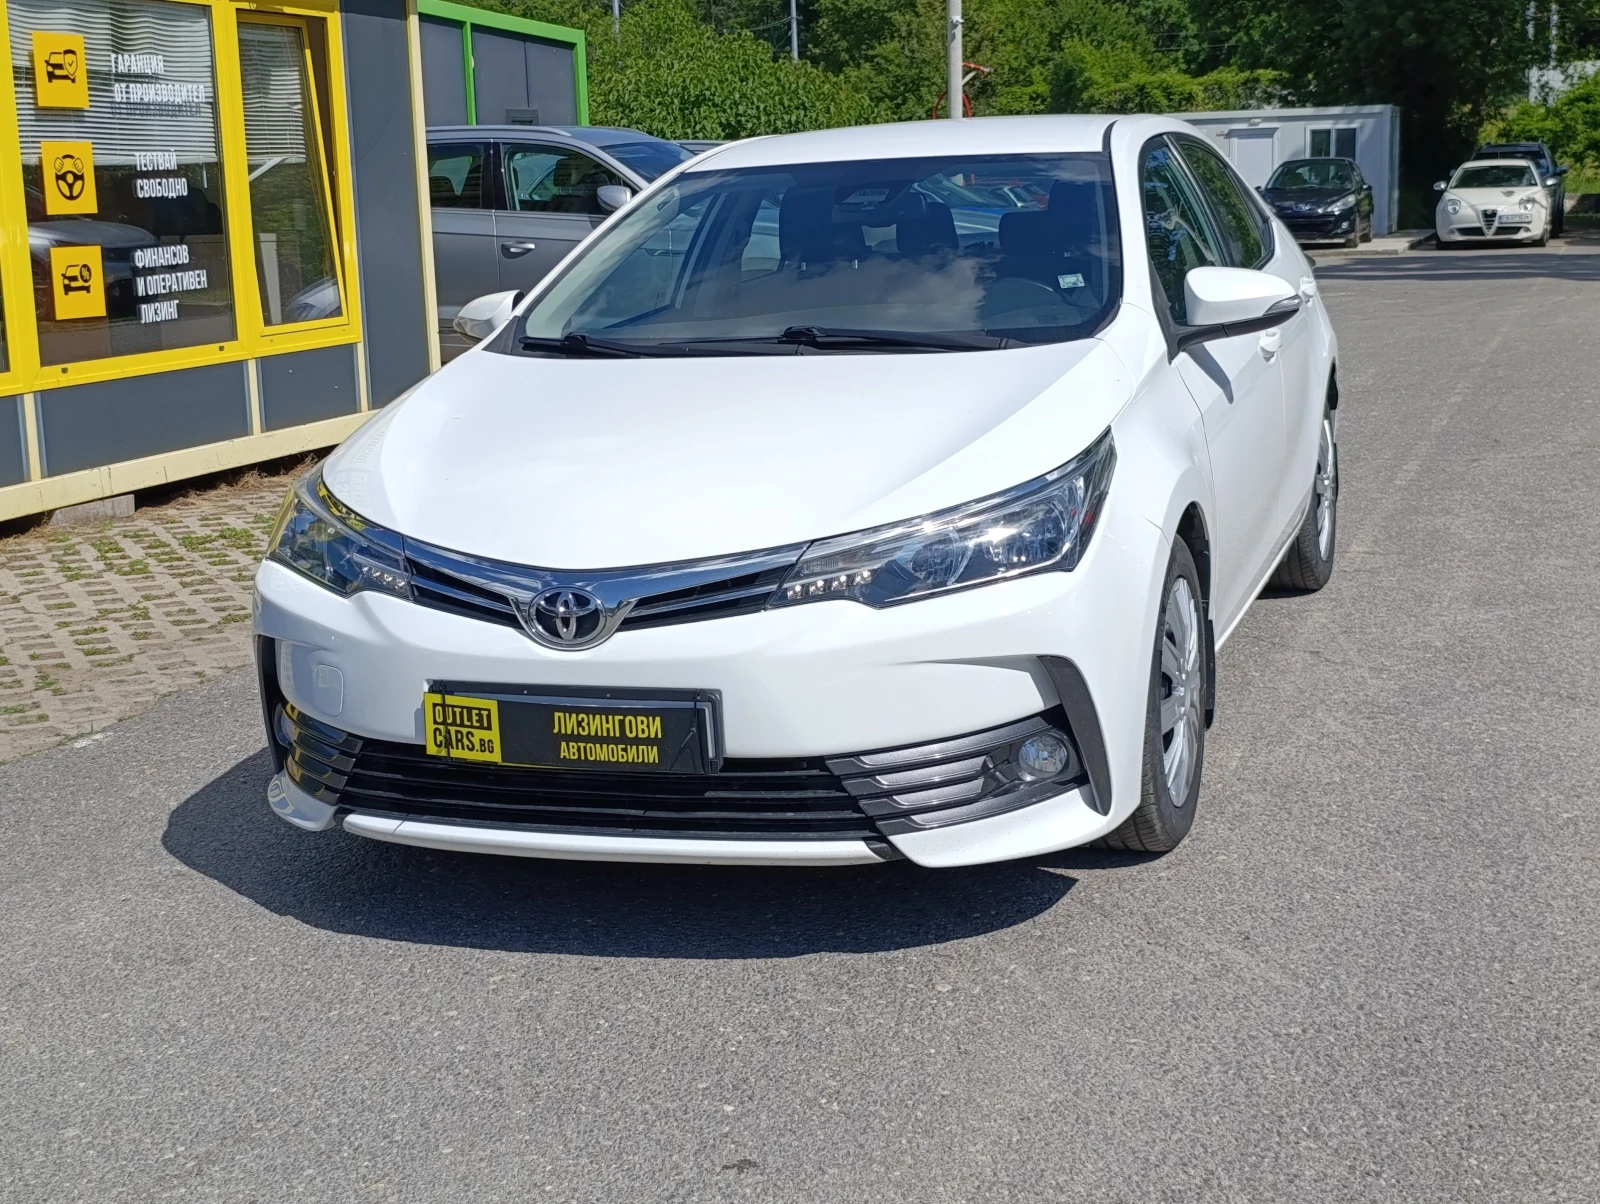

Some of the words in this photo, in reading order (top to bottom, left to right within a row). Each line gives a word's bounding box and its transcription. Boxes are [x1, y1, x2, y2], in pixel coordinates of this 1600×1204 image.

[110, 54, 164, 75] ГАРАНЦИЯ
[114, 84, 127, 102] ОТ
[129, 84, 205, 104] ПРОИЗВОДИТЕЛ
[134, 148, 178, 171] ТЕСТВАЙ
[136, 178, 188, 199] СВОБОДНО
[134, 244, 190, 268] ФИНАНСОВ
[136, 277, 146, 297] И
[146, 269, 208, 295] ОПЕРАТИВЕН
[140, 300, 179, 324] ЛИЗИНГ
[435, 705, 489, 727] OUTLET
[553, 712, 662, 739] ЛИЗИНГОВИ
[560, 741, 659, 763] АВТОМОБИЛИ
